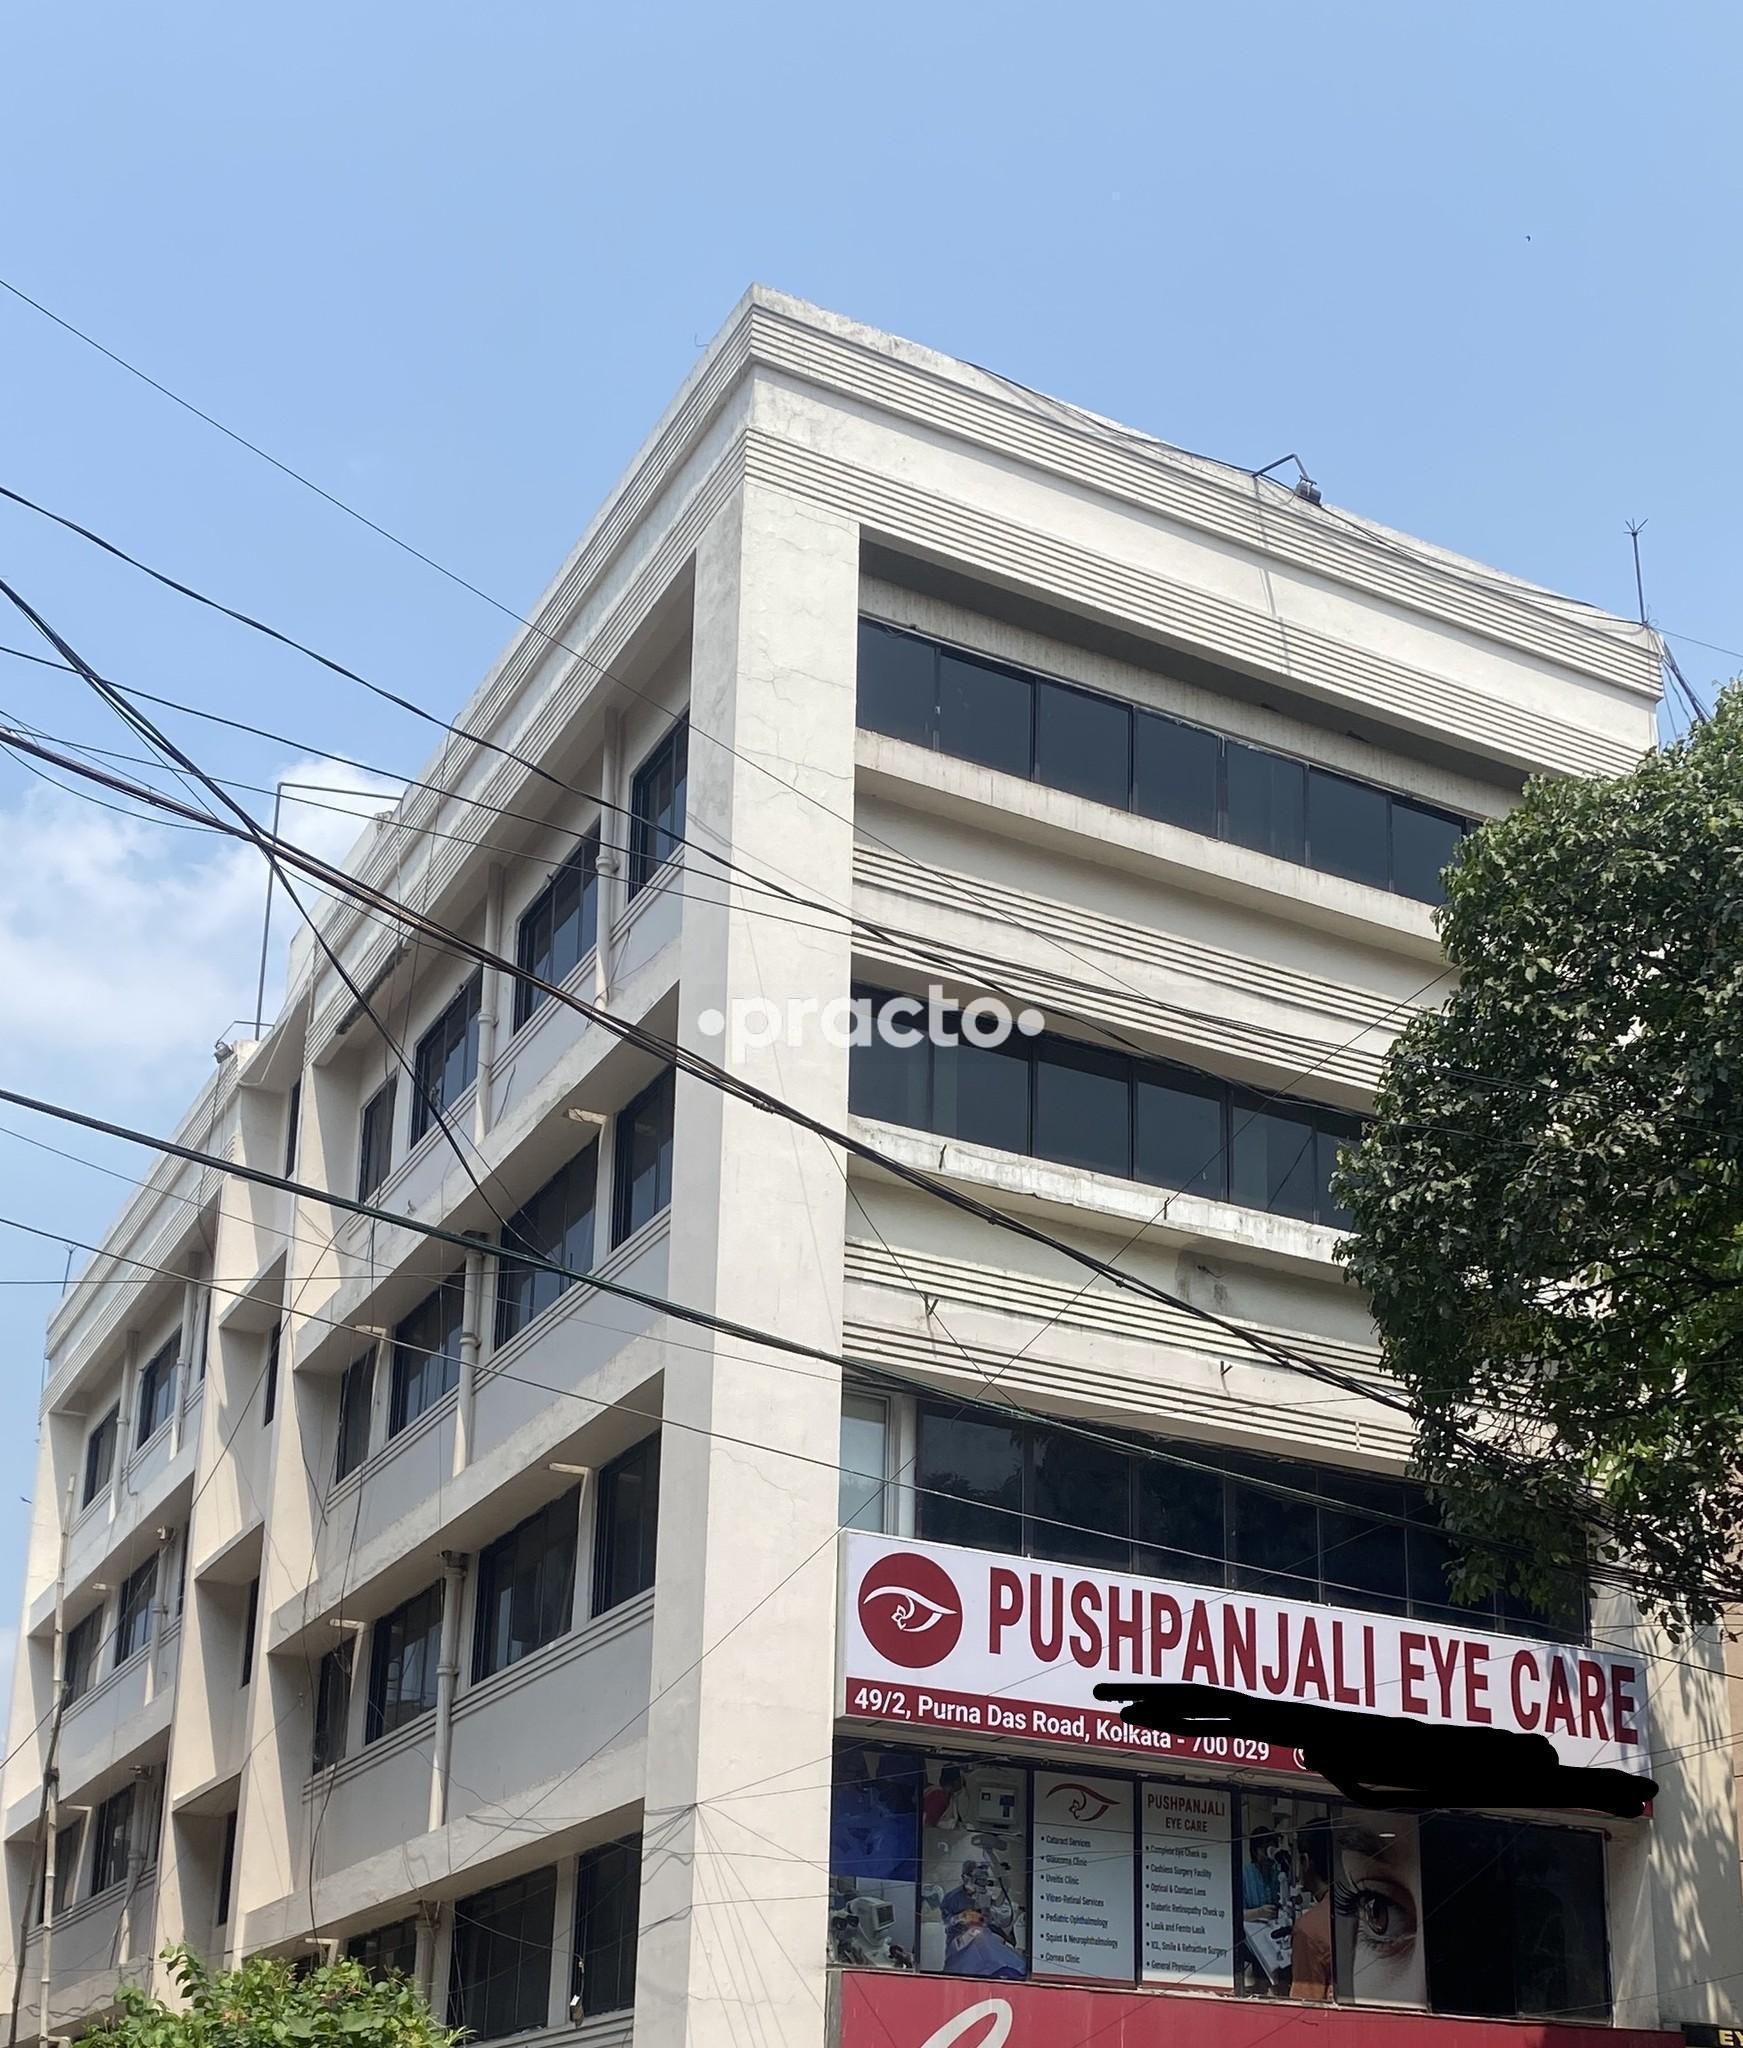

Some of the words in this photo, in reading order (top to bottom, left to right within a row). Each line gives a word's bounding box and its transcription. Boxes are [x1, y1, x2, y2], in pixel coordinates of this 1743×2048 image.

[988, 1566, 1375, 1708] PUSHPANJALI
[1400, 1631, 1492, 1725] EYE
[1511, 1649, 1638, 1745] CARE
[854, 1687, 911, 1719] 49/2,
[918, 1700, 981, 1725] Purna
[987, 1708, 1027, 1731] Das
[1033, 1714, 1090, 1744] Road,
[1096, 1720, 1172, 1750] Kolkata
[1232, 1739, 1270, 1762] 029
[1147, 1793, 1225, 1817] PUSHPANJALI
[1165, 1816, 1182, 1830] EYE
[1184, 1818, 1208, 1833] CARE
[1046, 1835, 1068, 1846] Cataract
[1069, 1837, 1091, 1848] Services
[1073, 1856, 1087, 1867] Clinic
[1151, 1863, 1173, 1874] Cashless
[1174, 1866, 1193, 1878] Surgery
[1194, 1868, 1212, 1880] Facility
[1064, 1875, 1080, 1885] Clinic
[1151, 1883, 1169, 1893] Optical
[1174, 1885, 1194, 1895] Contact
[1082, 1896, 1105, 1907] Services
[1151, 1902, 1171, 1912] Diabetic
[1202, 1906, 1217, 1917] Check
[1045, 1913, 1069, 1923] Pediatric
[1151, 1921, 1164, 1931] Lasik
[1165, 1923, 1175, 1932] and
[1192, 1925, 1206, 1935] Lasik
[1045, 1932, 1062, 1943] Squint
[1161, 1941, 1176, 1951] Smile
[1207, 1945, 1228, 1958] Surgery
[1045, 1952, 1064, 1962] Cornea
[1064, 1953, 1080, 1963] Clinic
[1151, 1960, 1171, 1970] General
